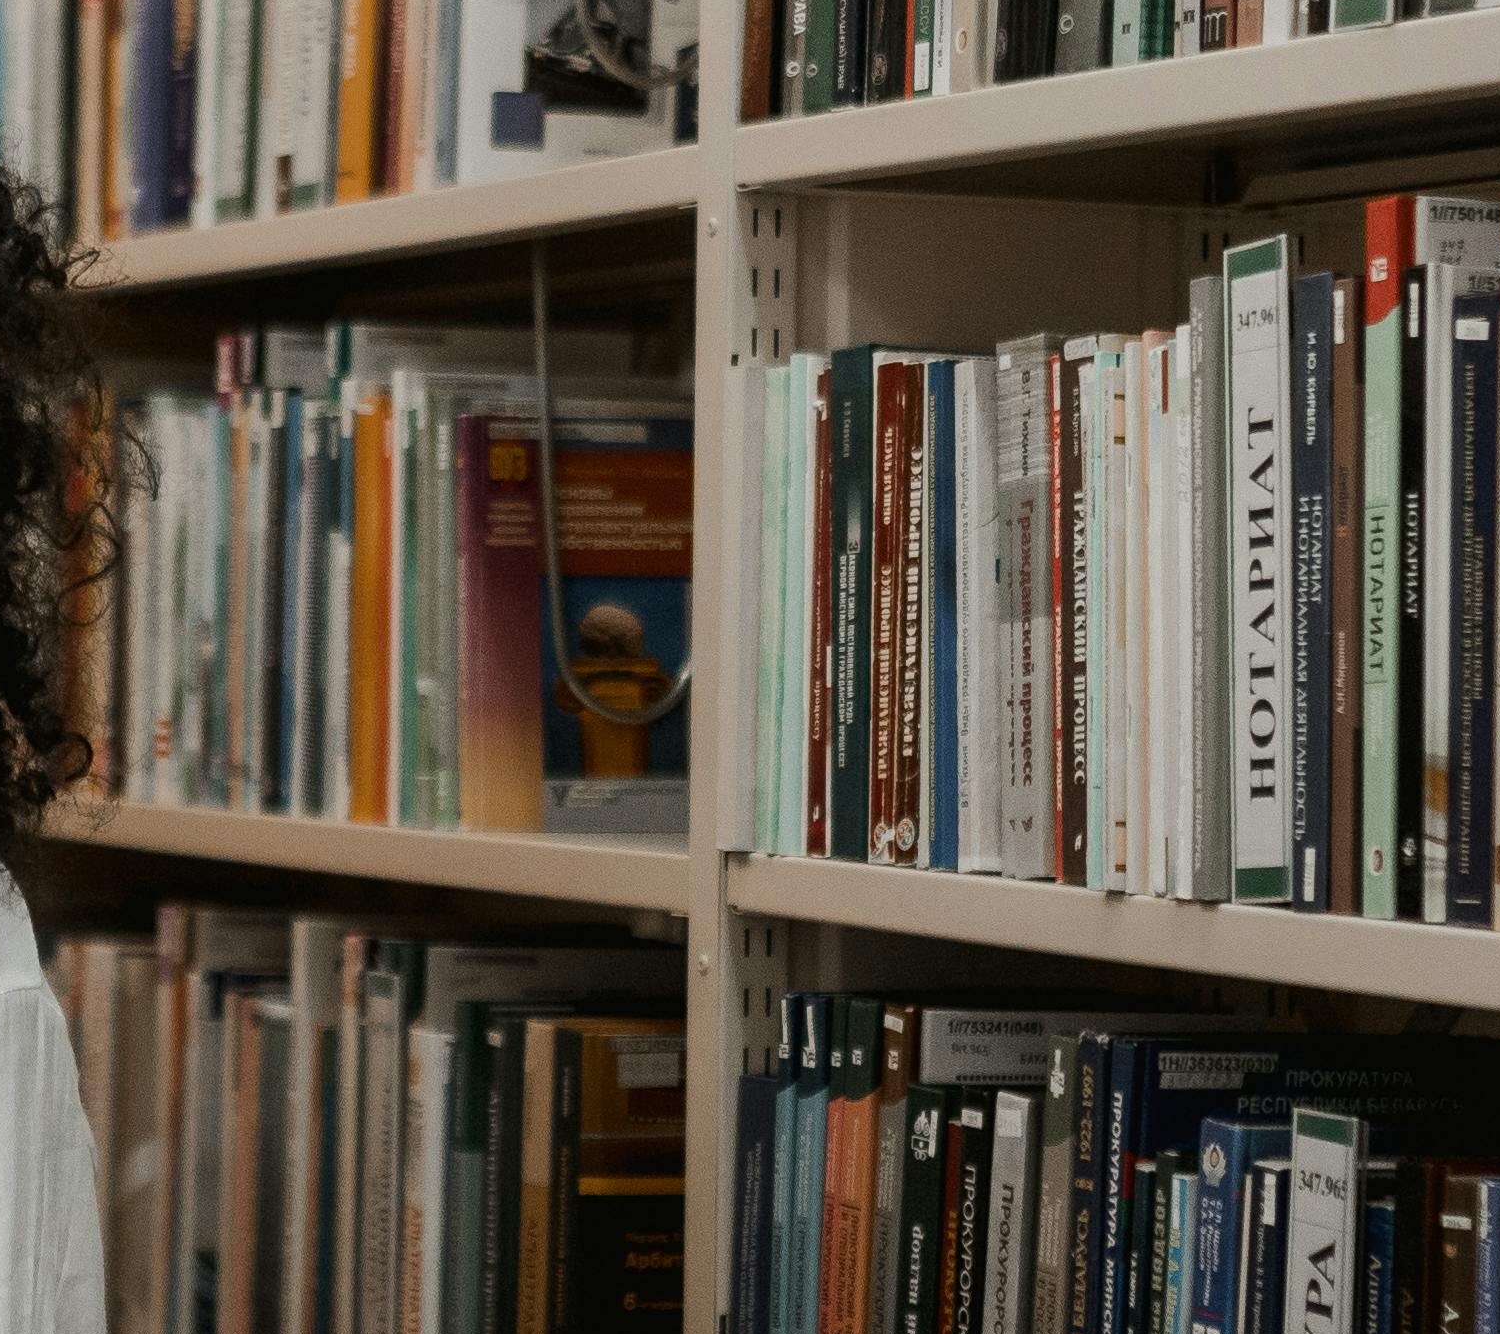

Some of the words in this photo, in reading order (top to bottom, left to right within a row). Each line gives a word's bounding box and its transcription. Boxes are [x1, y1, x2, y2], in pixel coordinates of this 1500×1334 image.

[883, 425, 893, 473] ЧАСТЬ
[1194, 375, 1203, 487] ГРАЖДАНСКОЕ
[1305, 376, 1316, 446] КИРВЕЛЬ
[882, 475, 893, 526] ОБЩАЯ
[907, 444, 924, 560] ПРОЦЕСС
[1298, 496, 1308, 509] И
[1311, 495, 1322, 605] НОТАРИАТ
[1404, 490, 1419, 620] НОТАРИАТ
[879, 564, 892, 643] ПРОЦЕСС
[1017, 498, 1034, 677] Гражданский
[1073, 489, 1086, 664] ГРАЖДАНСКИЙ
[1247, 406, 1276, 801] НОТАРИАТ
[1296, 512, 1309, 686] НОТАРИАЛЬНАЯ
[1369, 514, 1385, 674] НОТАРИАТ
[877, 646, 891, 780] ГРАЖДАНСКИЙ
[902, 566, 920, 758] ГРАЖДАНСКИЙ
[1019, 682, 1033, 787] процесс
[1073, 675, 1086, 787] ПРОЦЕСС
[1294, 688, 1306, 841] ДЕЯТЕЛЬНОСТЬ
[1194, 790, 1202, 872] БЕЛАРУСЬ
[1080, 1063, 1094, 1162] 1922-1997
[1236, 1097, 1359, 1118] РЕСПУБЛИКИ
[1285, 1069, 1415, 1089] ПРОКУРАТУРА
[1106, 1090, 1123, 1250] ПРОКУРАТУРА
[909, 1223, 924, 1306] надзор
[1071, 1207, 1090, 1328] БЕЛАРУСЬ
[1150, 1186, 1167, 1293] НАДЗОР
